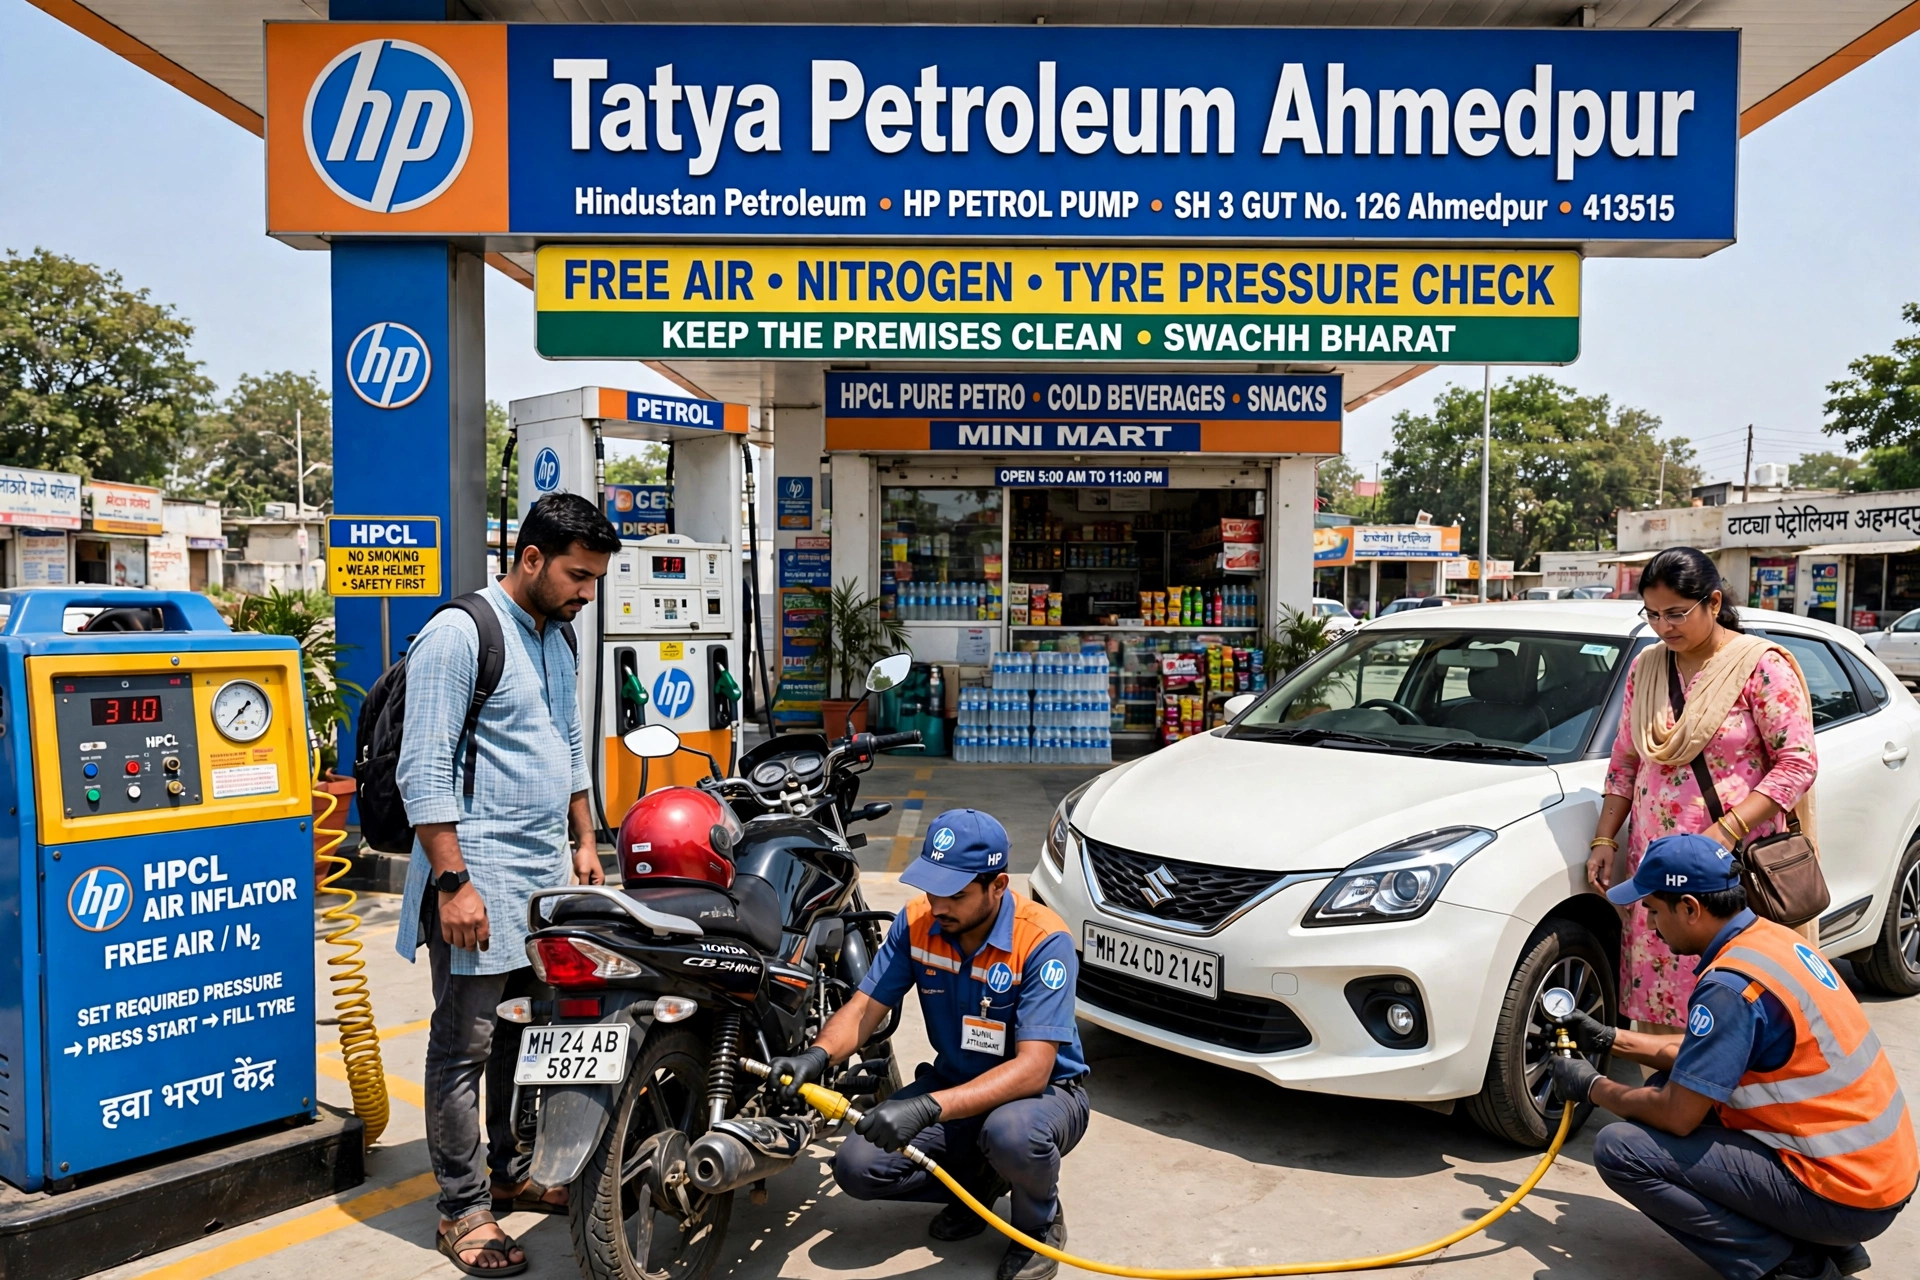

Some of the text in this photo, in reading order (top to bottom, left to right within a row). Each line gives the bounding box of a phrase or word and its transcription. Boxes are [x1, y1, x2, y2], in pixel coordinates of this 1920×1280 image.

[326, 40, 451, 212] hp
[554, 59, 1694, 180] Tatya Petroleum Ahmedpur
[576, 187, 1674, 226] Hindustan Petroleum HP PETROL PUMP SH 3 GUT No. 126 Ahmedpur 413515
[566, 260, 1552, 305] FREE AIR NITROGEN TYRE PRESSURE CHECK
[664, 322, 1456, 352] KEEP THE PREMISES CLEAN SWACHH BHARAT
[358, 323, 419, 407] hp
[637, 398, 714, 425] PETROL
[842, 383, 1326, 411] HPCL PURE PETRO COLD BEVERAGES SNACKS
[959, 426, 1171, 446] MINI MART
[1001, 471, 1162, 482] OPEN 5:00 AM TO 11:00 PM
[350, 524, 417, 544] HPCL
[1728, 515, 1771, 535] टाट्या
[1775, 505, 1849, 539] पेट्रोलियम
[346, 564, 425, 575] WEAR HELMET
[348, 550, 419, 562] NO SMOKING
[350, 579, 426, 590] SAFETY FIRST
[657, 668, 690, 719] hp
[106, 698, 157, 723] 31.0
[930, 850, 944, 861] HP
[988, 852, 1002, 866] HP
[144, 855, 228, 891] HPCL
[1665, 874, 1688, 887] HP
[77, 869, 125, 930] hp
[143, 878, 297, 922] AIR INFLATOR
[105, 937, 168, 970] FREE
[174, 930, 214, 958] AIR
[221, 925, 229, 952] /
[700, 944, 749, 956] HONDA
[1097, 934, 1213, 988] MH 24 CD 2145
[683, 957, 760, 974] CB SHINE
[990, 962, 1011, 993] hp
[1044, 959, 1063, 990] hp
[78, 972, 282, 1027] SET REQUIRED PRESSURE
[88, 996, 295, 1055] PRESS START FILL TYRE
[1690, 1005, 1711, 1036] hp
[527, 1030, 618, 1054] MH 24 AB
[546, 1056, 598, 1079] 5872
[100, 1057, 277, 1129] हवा भरण केंद्र
